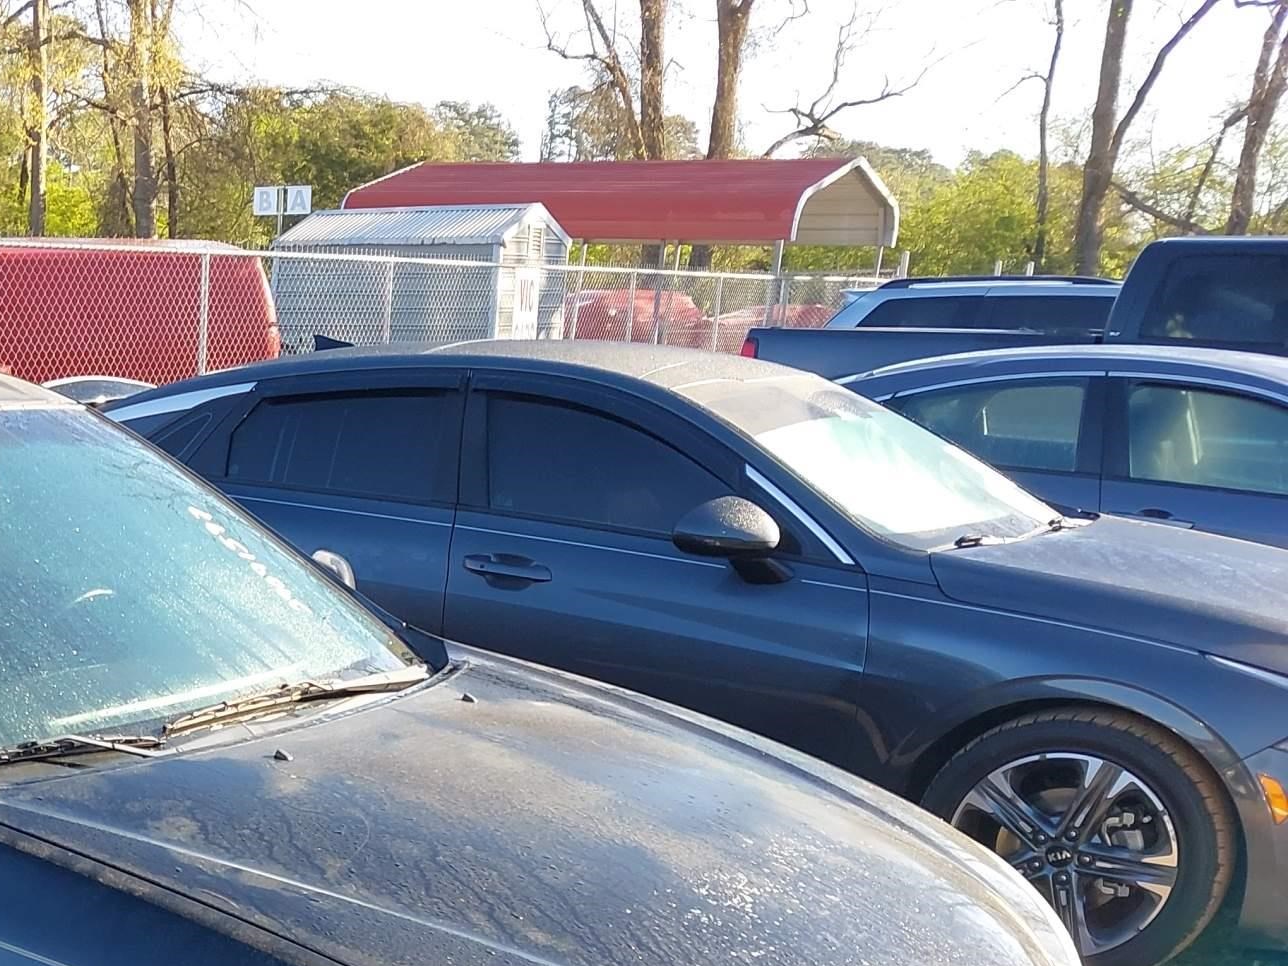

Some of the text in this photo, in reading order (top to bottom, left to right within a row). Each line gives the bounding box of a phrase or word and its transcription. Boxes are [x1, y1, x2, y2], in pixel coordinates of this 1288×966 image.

[258, 190, 272, 212] B
[289, 189, 307, 211] A
[1048, 850, 1071, 862] KIA
